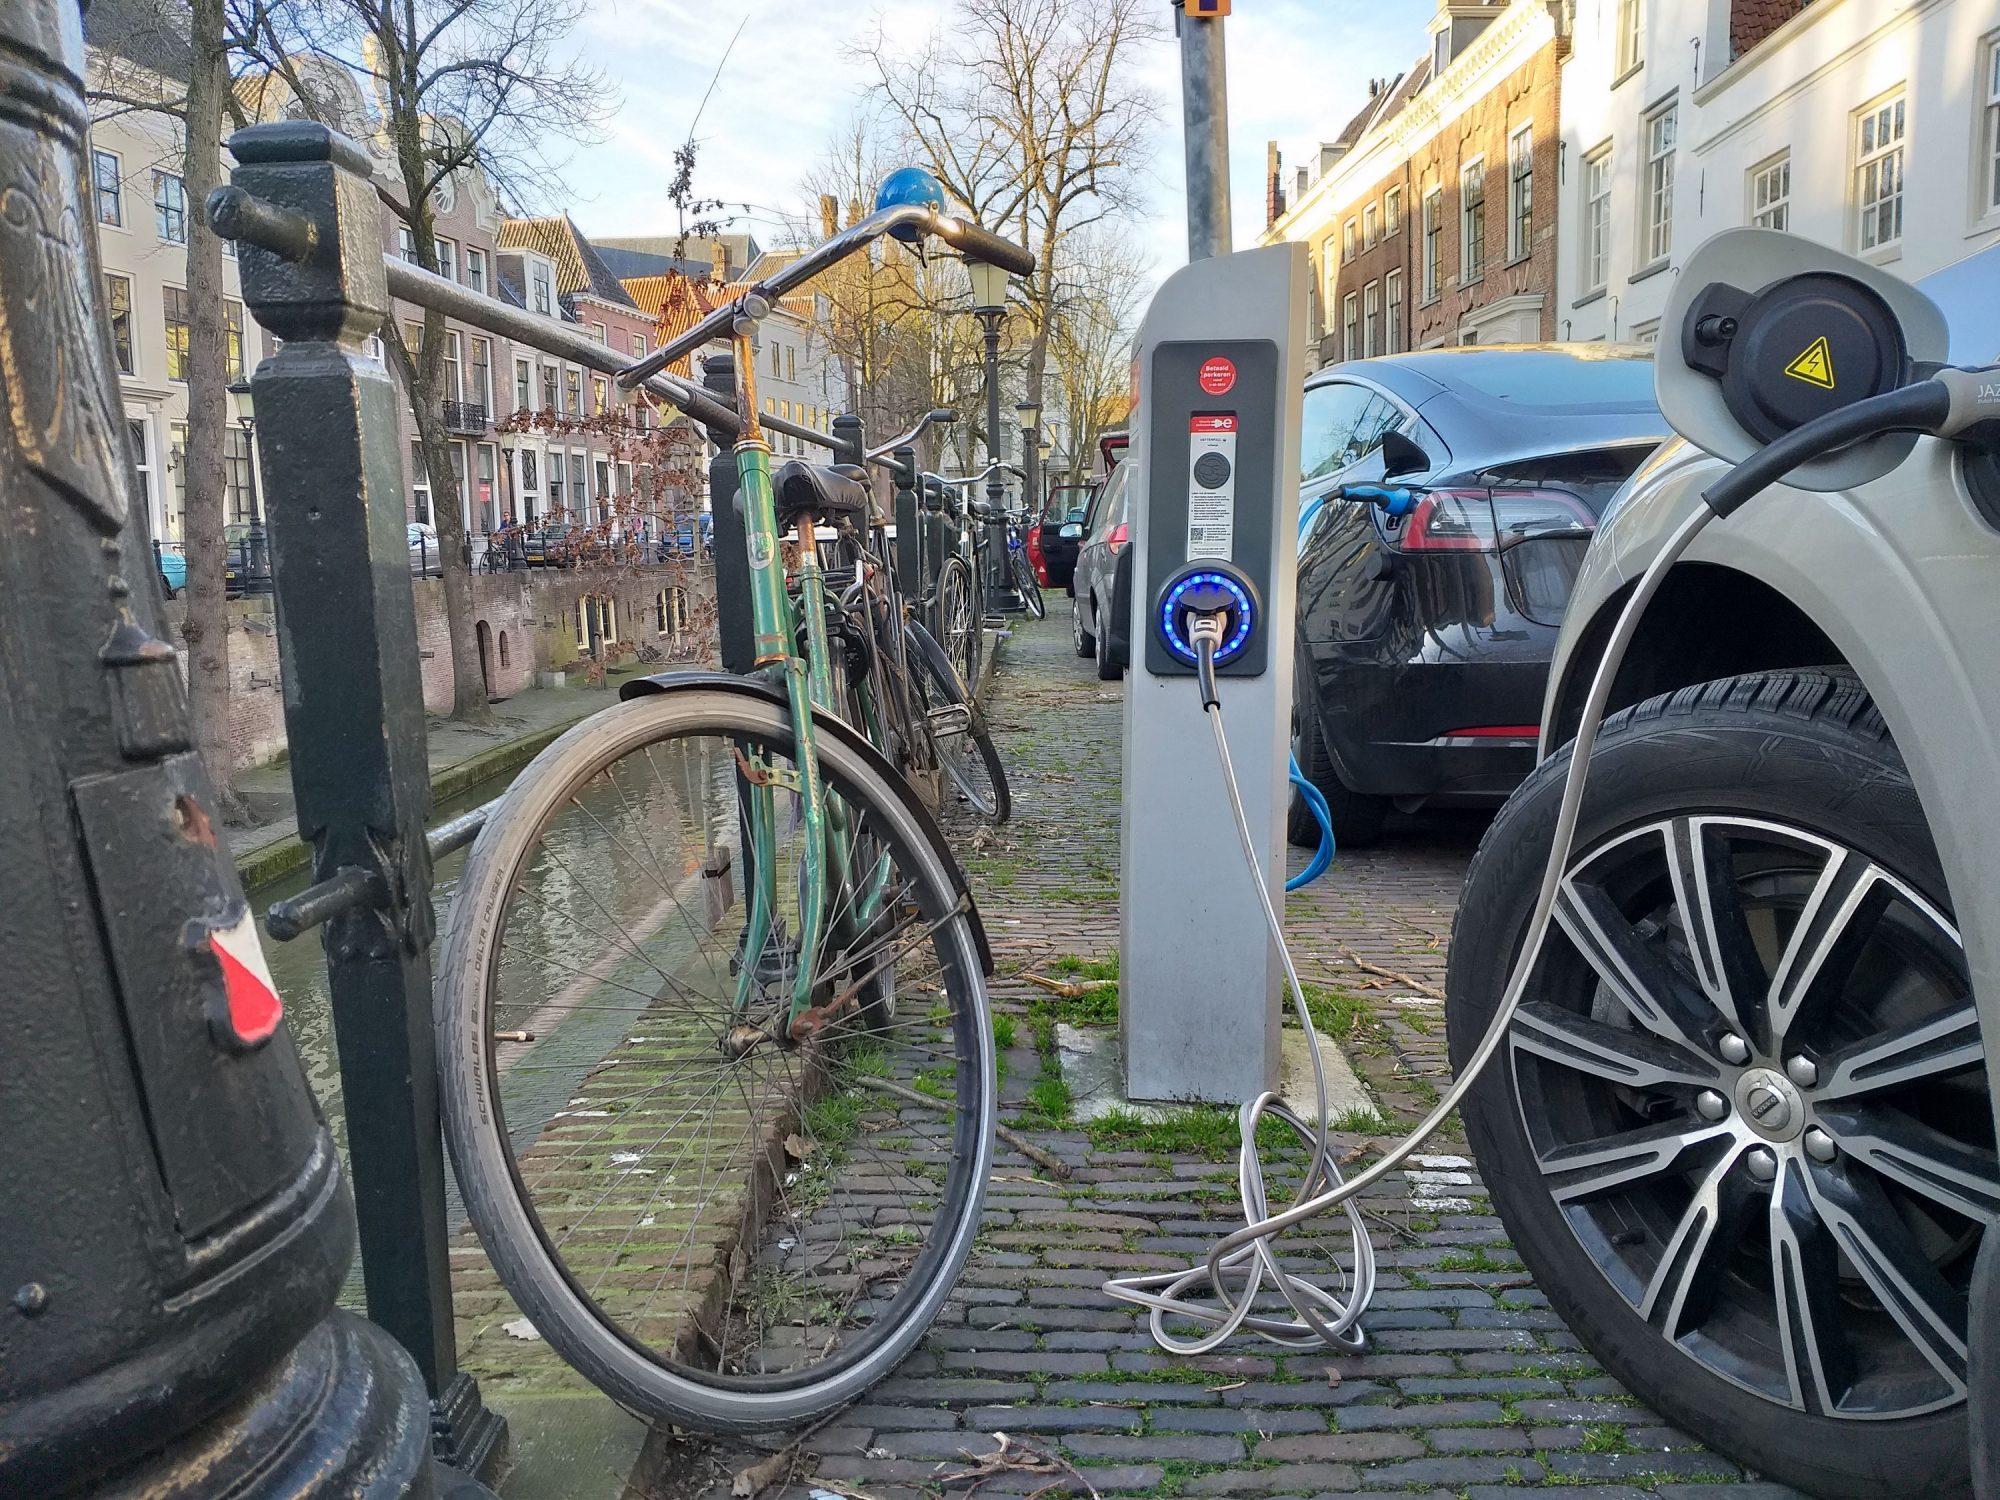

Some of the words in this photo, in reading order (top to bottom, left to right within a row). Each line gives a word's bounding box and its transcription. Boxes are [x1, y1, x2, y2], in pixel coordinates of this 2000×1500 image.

[483, 867, 504, 923] CRUISER
[474, 928, 488, 973] DELTA
[471, 1031, 489, 1126] SCHWALBE
